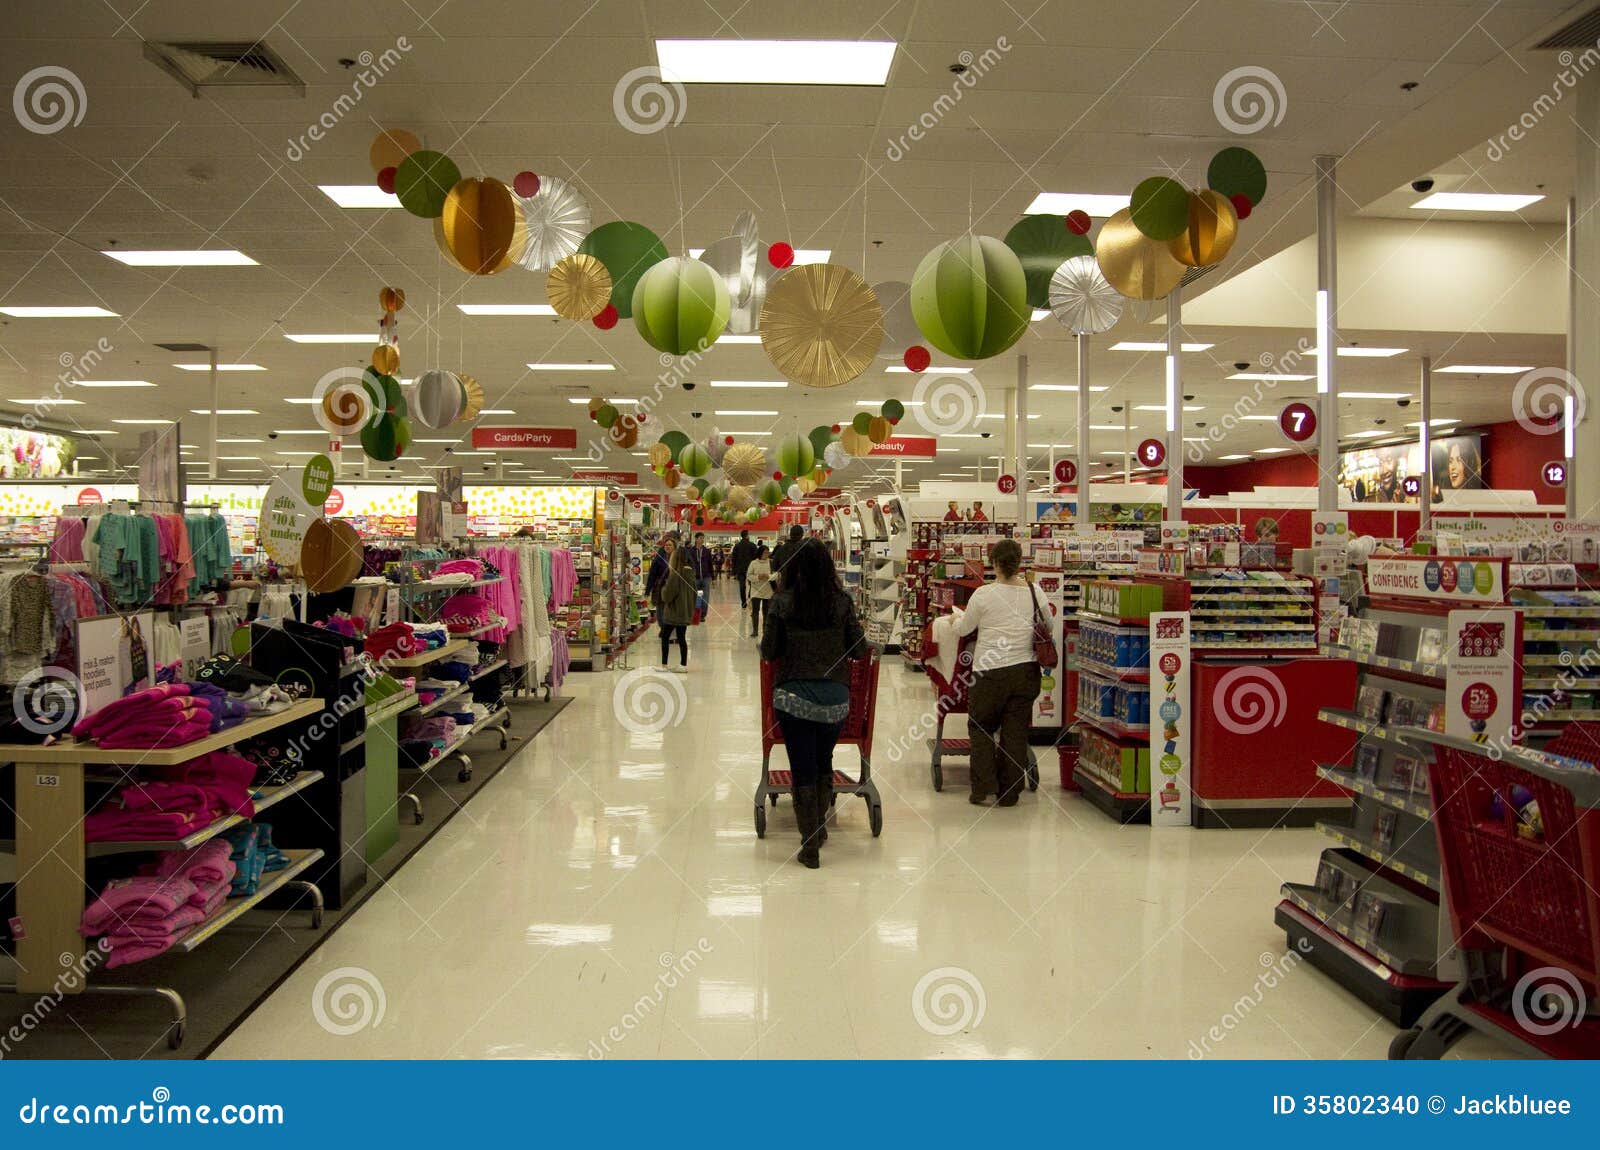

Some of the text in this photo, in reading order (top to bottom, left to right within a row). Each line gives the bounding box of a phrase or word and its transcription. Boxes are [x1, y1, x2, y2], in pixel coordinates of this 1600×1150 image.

[1291, 412, 1306, 432] 7
[494, 433, 552, 445] Cards/Party
[873, 442, 905, 452] Beauty
[1146, 445, 1158, 460] 9
[1061, 467, 1072, 477] 11
[1548, 468, 1563, 480] 12
[1001, 480, 1013, 489] 13
[1405, 481, 1418, 491] 14
[1372, 574, 1419, 589] CONFIDENCE
[39, 776, 57, 785] L33
